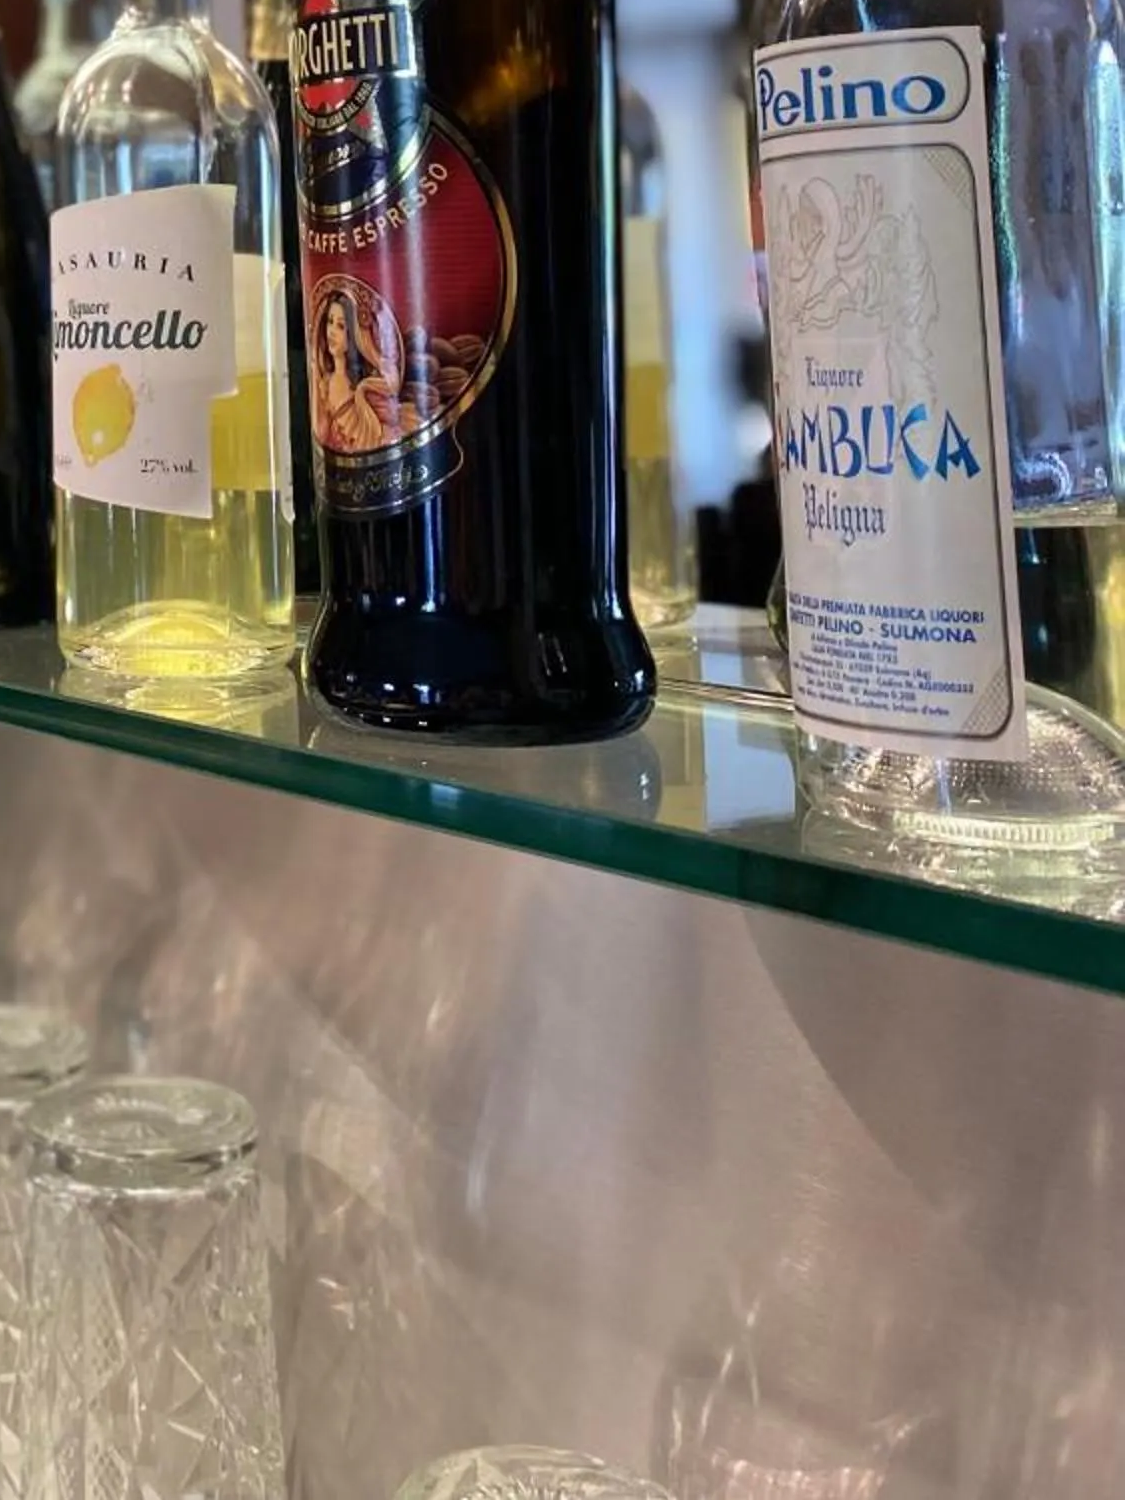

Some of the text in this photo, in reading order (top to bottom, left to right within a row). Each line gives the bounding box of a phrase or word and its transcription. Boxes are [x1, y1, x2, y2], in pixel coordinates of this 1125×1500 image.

[288, 11, 398, 80] ORGHETTI
[757, 64, 947, 131] Pelino
[354, 162, 449, 249] ESPRESSO
[54, 309, 208, 352] moncello
[804, 355, 864, 396] Liquore
[778, 403, 982, 482] AMBUCA
[880, 621, 977, 644] SULMONA
[930, 610, 985, 624] LIQUORI
